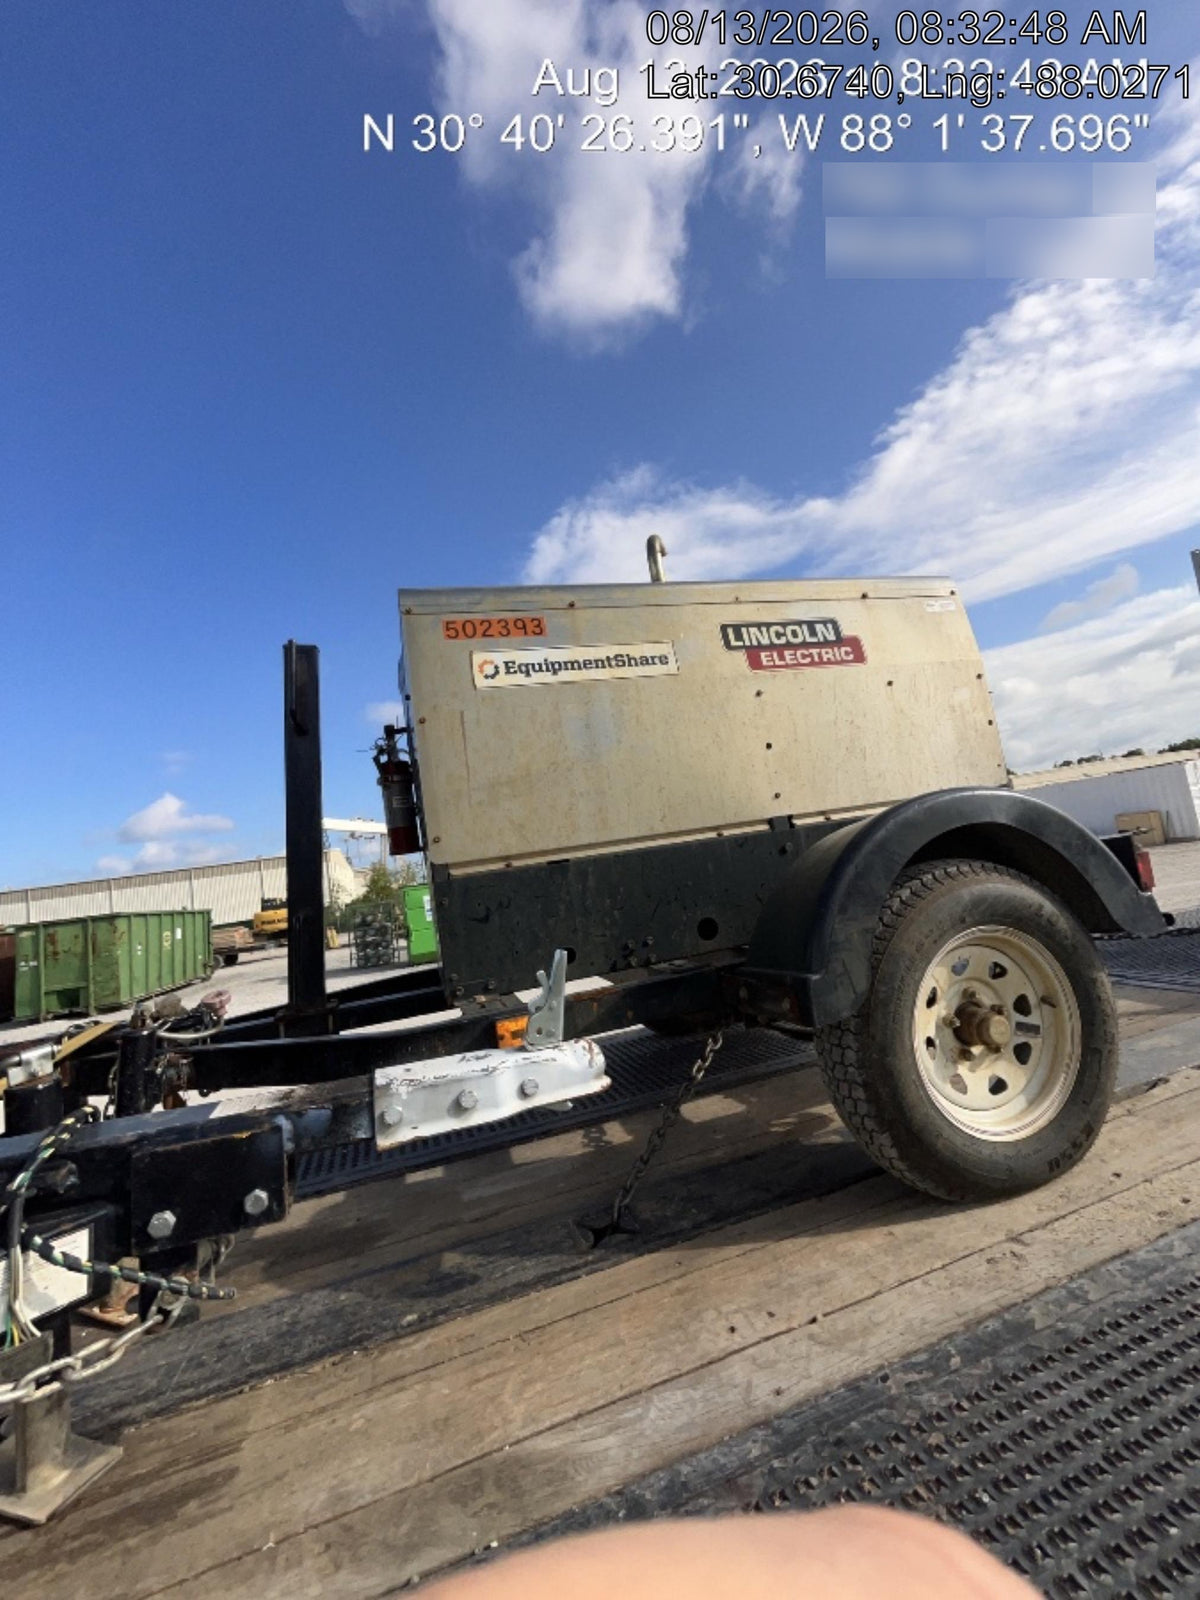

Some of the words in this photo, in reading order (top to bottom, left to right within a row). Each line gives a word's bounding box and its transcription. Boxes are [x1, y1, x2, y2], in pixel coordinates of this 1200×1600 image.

[445, 617, 545, 640] 502393
[726, 621, 837, 647] LINCOLN
[503, 652, 670, 678] EquipmentShare
[759, 646, 855, 668] ELECTRIC
